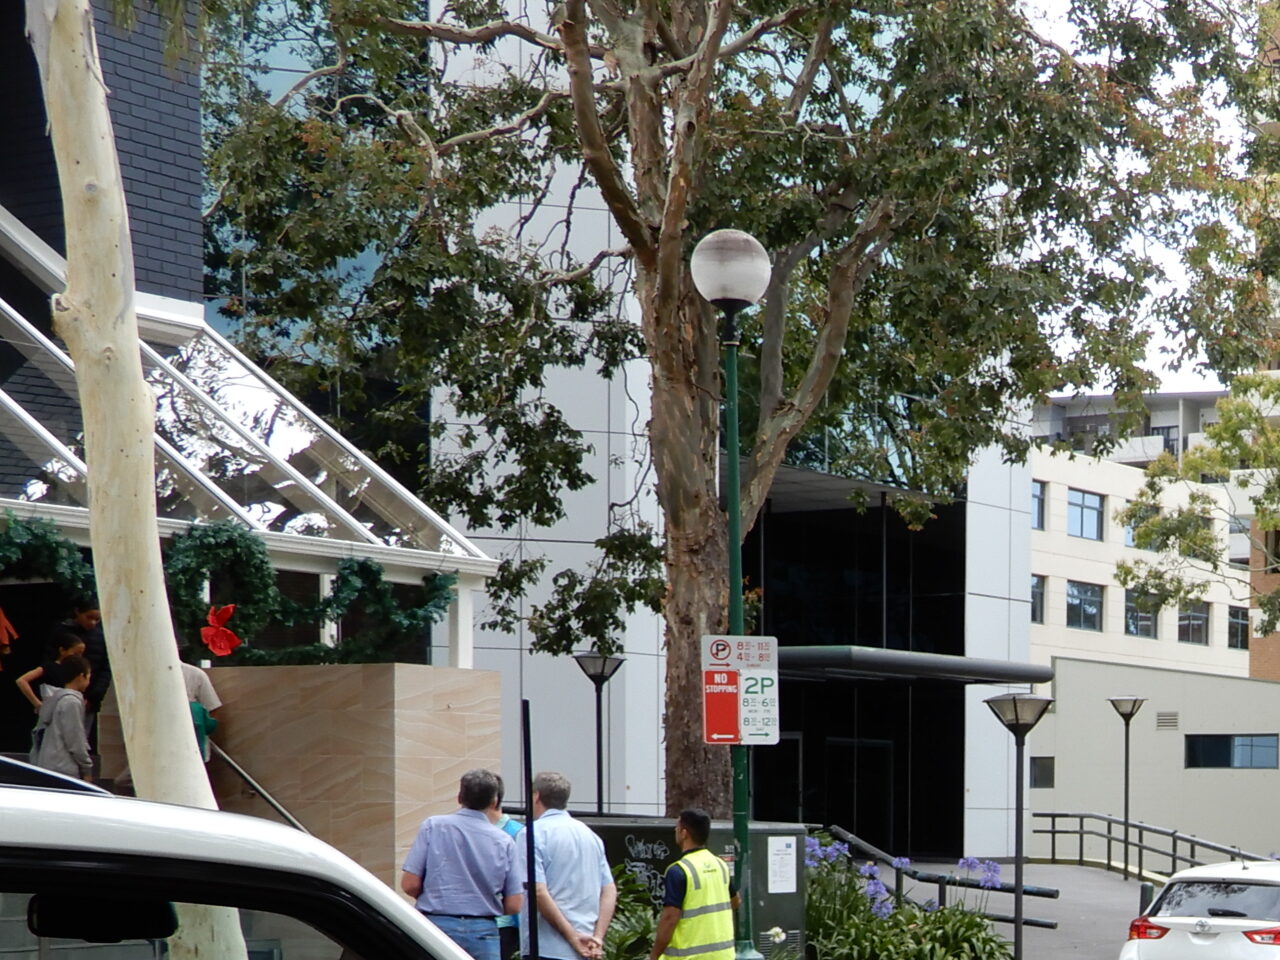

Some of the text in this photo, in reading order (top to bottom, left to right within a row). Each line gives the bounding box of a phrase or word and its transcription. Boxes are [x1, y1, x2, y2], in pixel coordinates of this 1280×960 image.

[713, 673, 728, 684] NO
[705, 684, 738, 693] STOPPING
[744, 677, 775, 695] 2P
